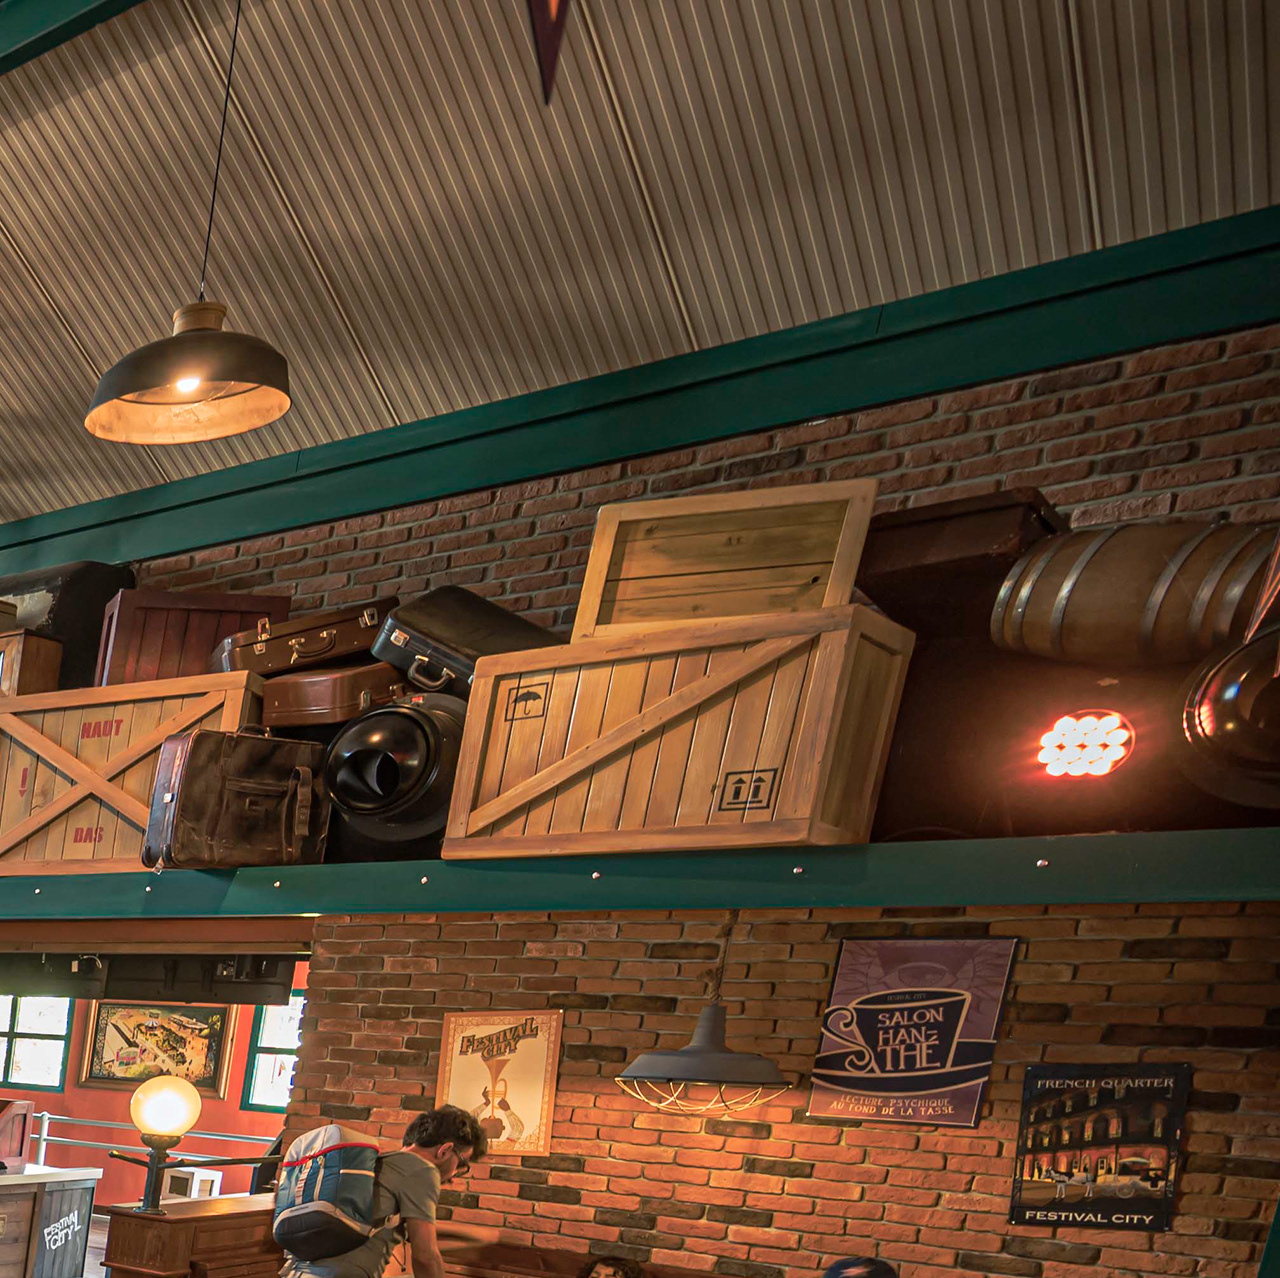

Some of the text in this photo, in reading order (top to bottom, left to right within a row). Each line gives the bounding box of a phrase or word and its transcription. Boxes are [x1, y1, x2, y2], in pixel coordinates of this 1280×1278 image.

[80, 719, 124, 740] HAUT
[73, 827, 104, 844] BAS
[877, 1007, 944, 1028] SALON
[459, 1017, 539, 1055] FESTIVAL
[481, 1039, 518, 1061] CITY
[1037, 1078, 1175, 1089] FRENCH QUARTER
[830, 1101, 845, 1110] AU
[881, 1106, 895, 1115] DE
[900, 1107, 914, 1116] LA
[920, 1106, 955, 1116] TASSE
[840, 1094, 951, 1107] LECTURE PSYCHIQUE
[1025, 1211, 1155, 1225] FESTIVAL CITY
